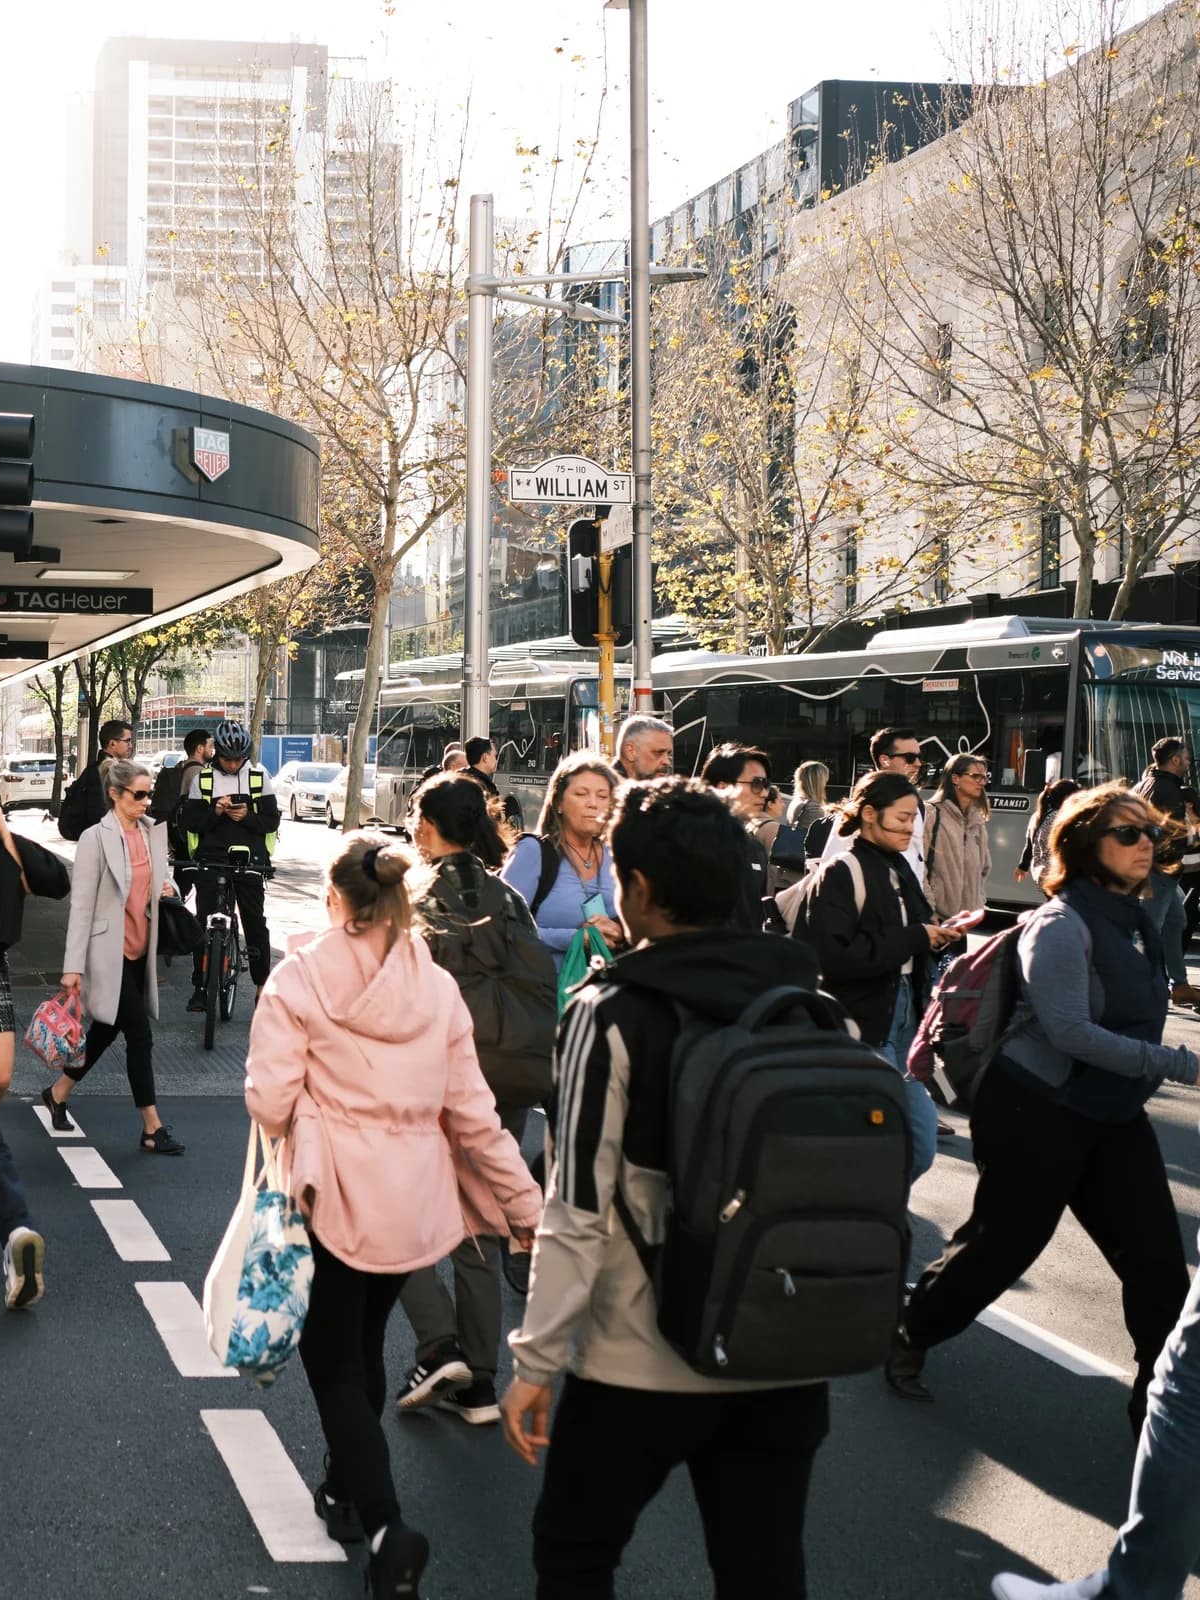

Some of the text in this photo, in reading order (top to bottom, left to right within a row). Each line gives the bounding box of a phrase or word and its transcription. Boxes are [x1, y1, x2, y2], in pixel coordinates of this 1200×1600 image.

[197, 431, 226, 451] TAG
[197, 451, 228, 476] HEUER
[535, 477, 626, 499] WILLIAM ST
[1162, 650, 1189, 666] Not
[1155, 665, 1200, 680] Servic
[993, 798, 1028, 808] TRANSIT
